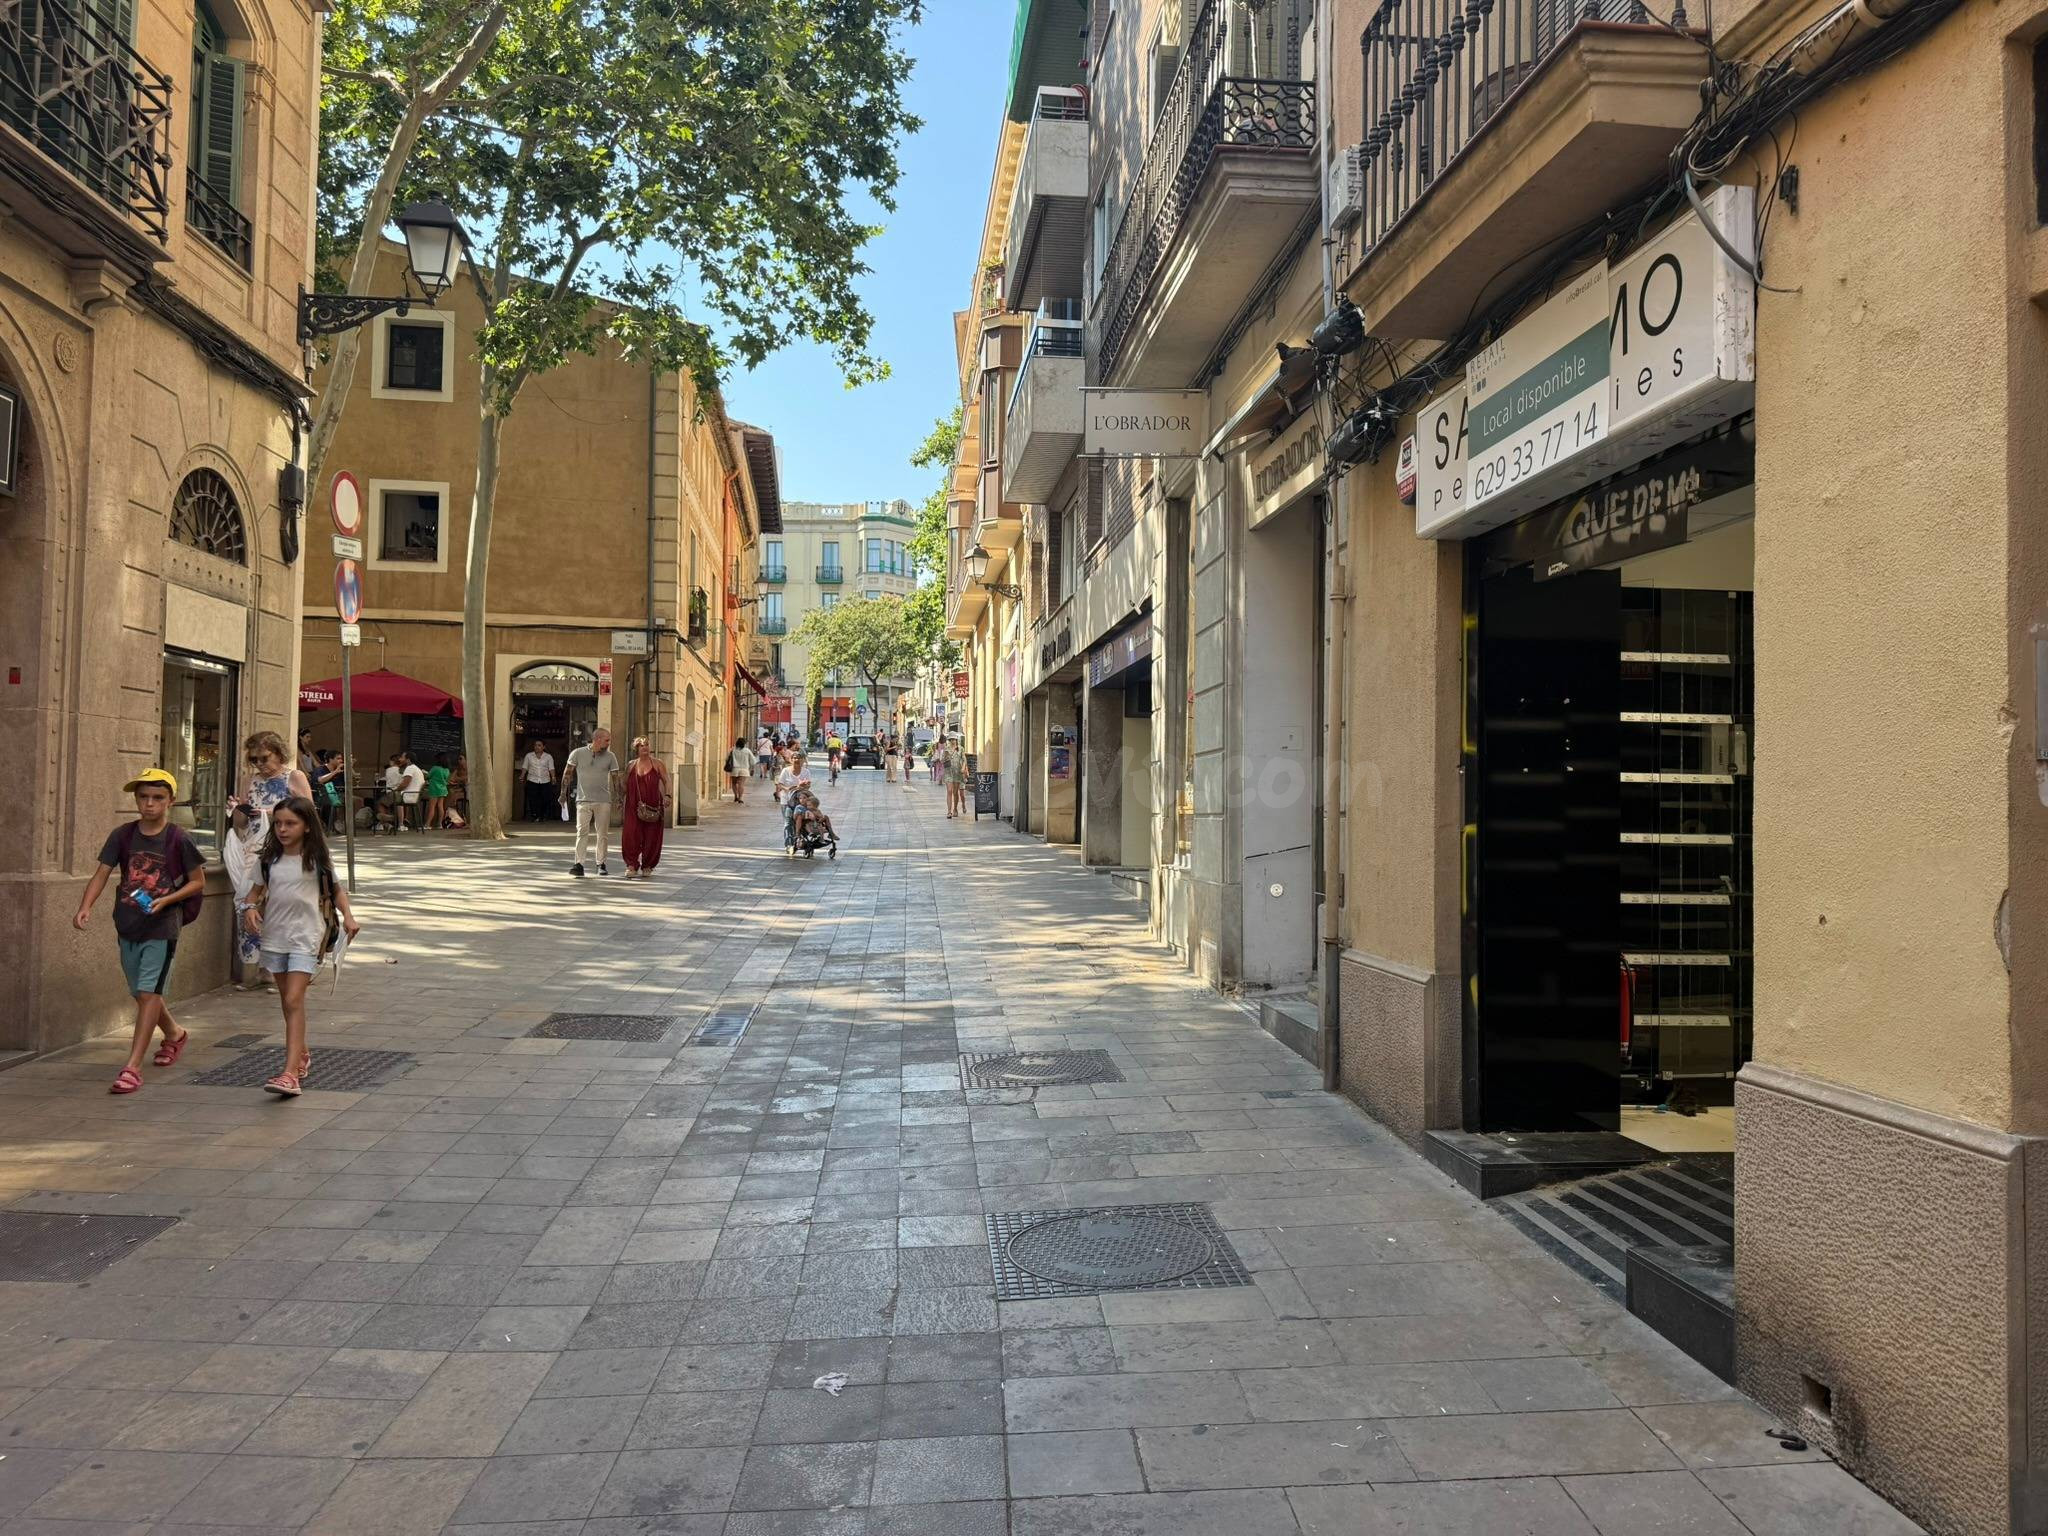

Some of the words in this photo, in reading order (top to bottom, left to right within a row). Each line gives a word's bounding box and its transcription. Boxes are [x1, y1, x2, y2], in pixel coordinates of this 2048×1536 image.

[1470, 338, 1506, 375] RETAIL
[1483, 397, 1513, 437] Local
[1517, 355, 1587, 411] disponible
[1094, 415, 1192, 431] L'OBRADOR
[1474, 455, 1506, 501] 629
[1511, 439, 1534, 482] 33
[1541, 420, 1565, 467] 77
[1573, 401, 1598, 448] 14
[299, 691, 334, 700] STRELLA
